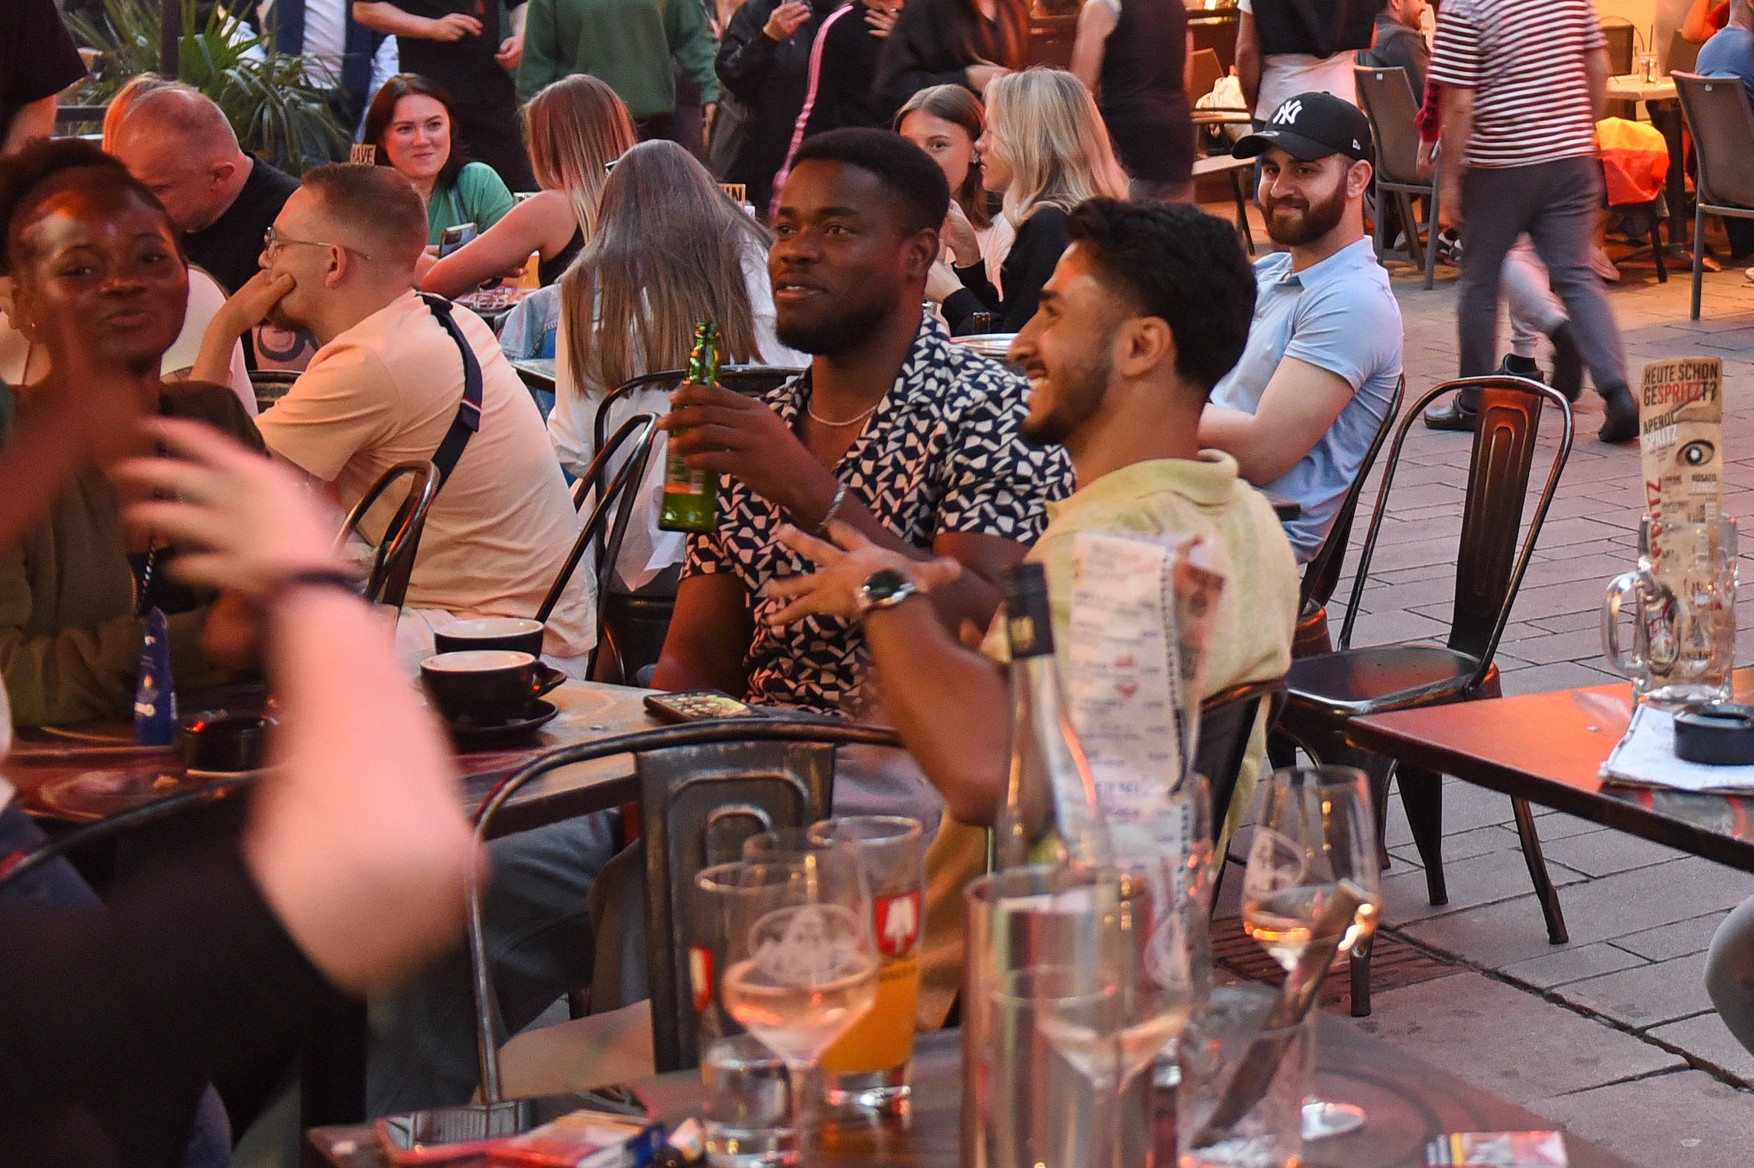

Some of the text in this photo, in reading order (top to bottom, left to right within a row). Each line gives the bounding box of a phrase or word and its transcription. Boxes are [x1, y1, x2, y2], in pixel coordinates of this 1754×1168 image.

[1644, 362, 1718, 385] HEUTE SCHON
[1643, 380, 1717, 407] GESPRITZT?
[1643, 411, 1679, 434] APEROL
